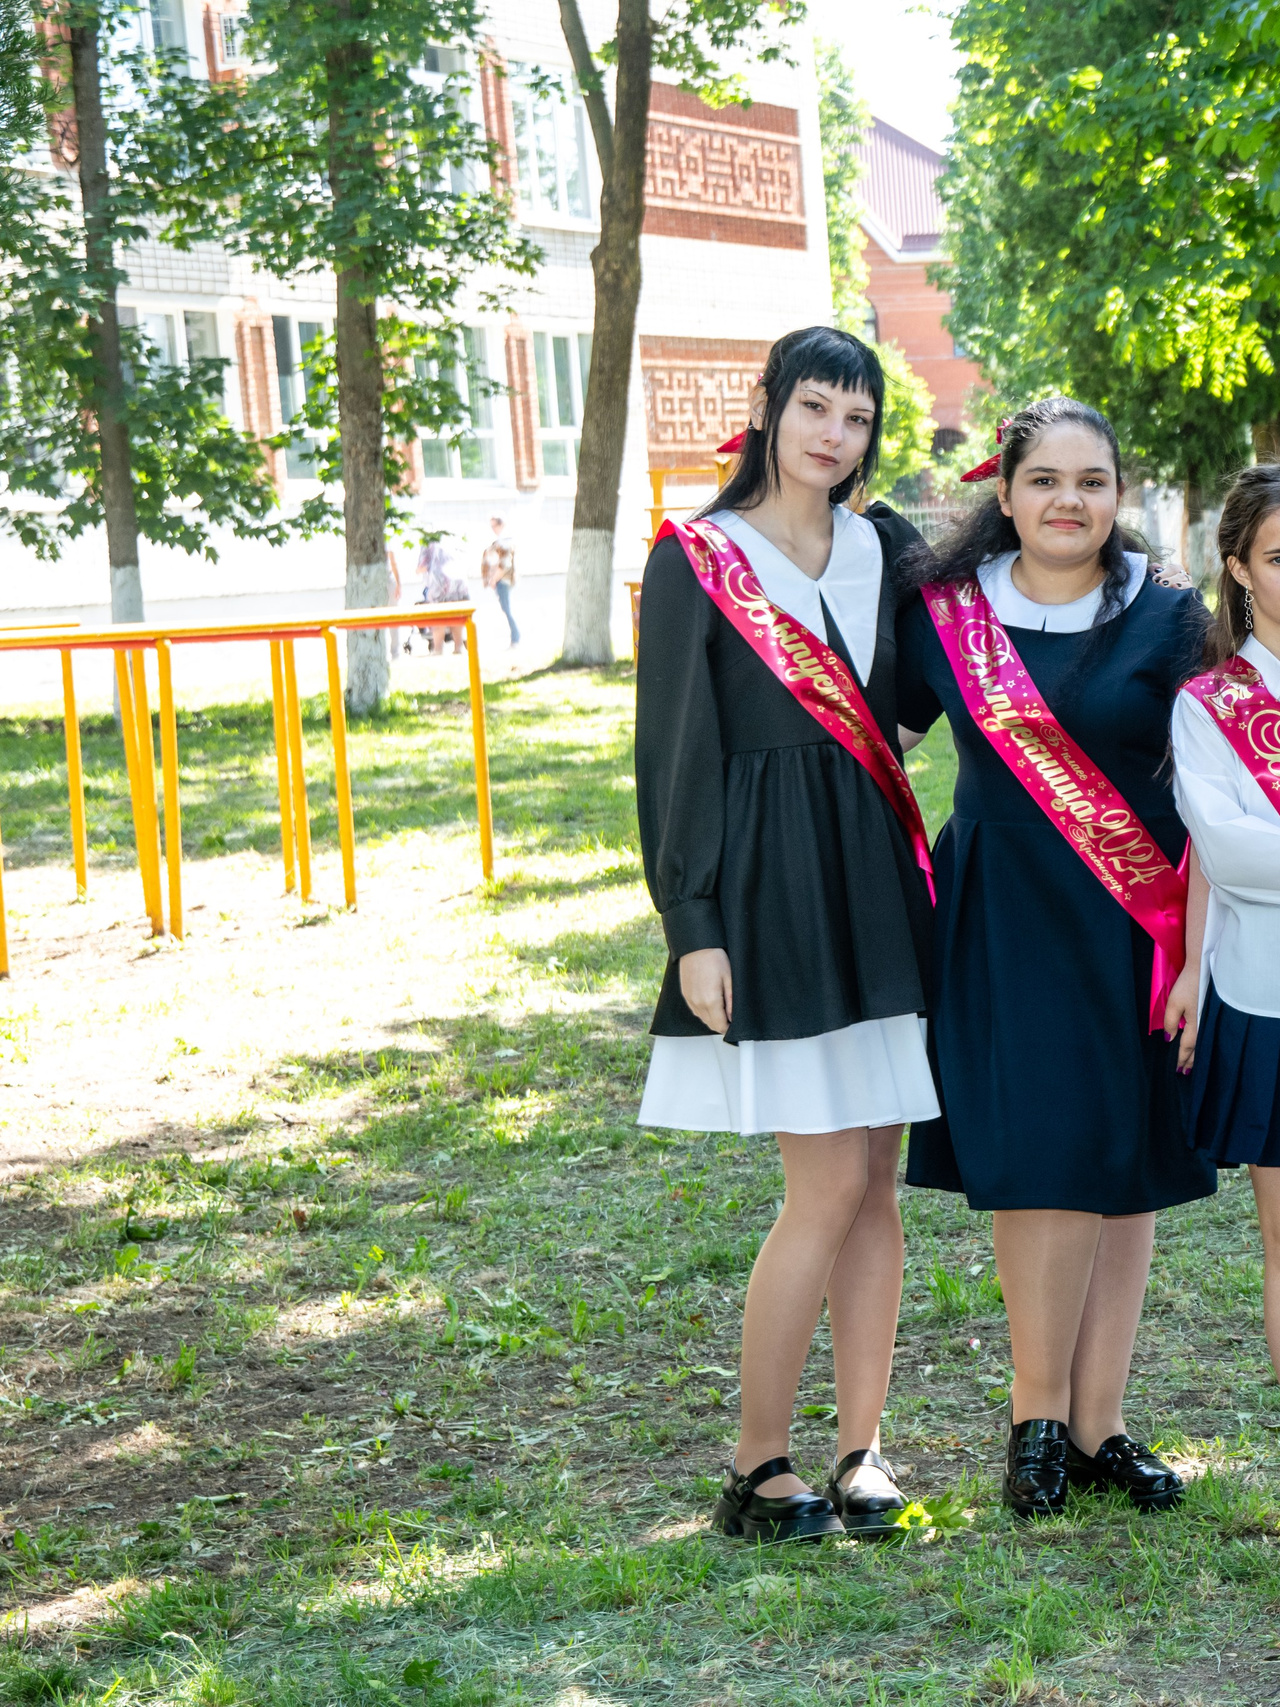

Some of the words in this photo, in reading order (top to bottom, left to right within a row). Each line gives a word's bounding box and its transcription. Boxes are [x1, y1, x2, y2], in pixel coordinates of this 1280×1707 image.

[824, 656, 837, 665] 9
[1026, 707, 1041, 718] 9
[958, 618, 1097, 824] Выпускница
[1083, 808, 1172, 888] 2024
[1068, 824, 1124, 896] Краснодар
